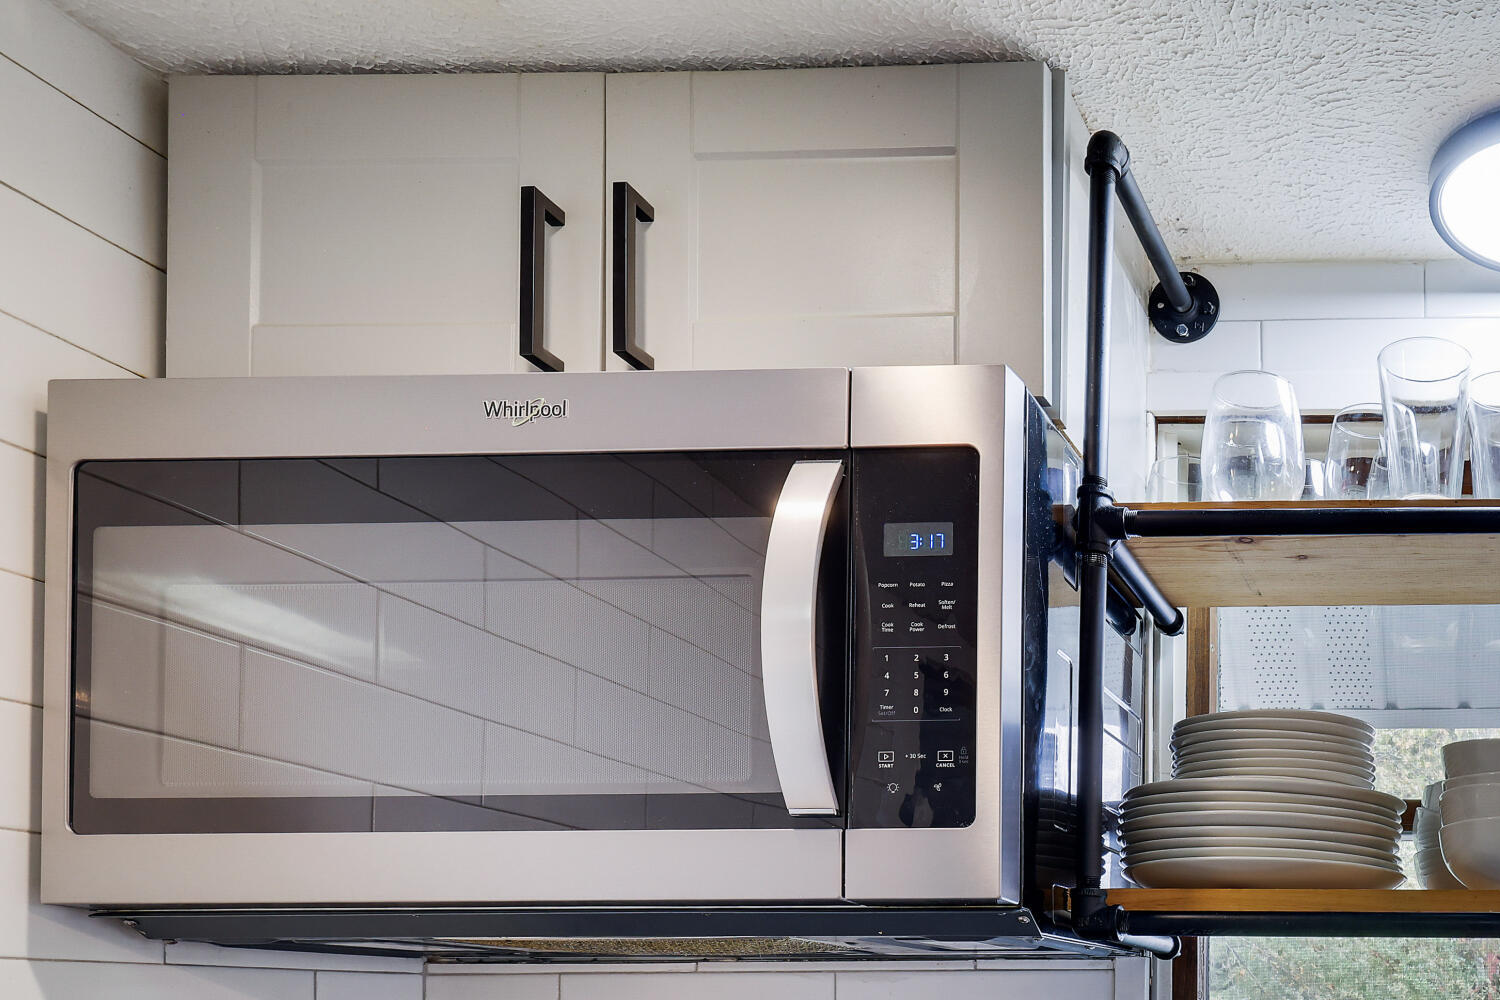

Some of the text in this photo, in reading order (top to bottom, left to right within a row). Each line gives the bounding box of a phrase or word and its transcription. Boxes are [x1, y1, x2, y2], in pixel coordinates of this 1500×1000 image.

[483, 400, 567, 422] Whirlpool
[910, 533, 945, 550] 3:17
[884, 654, 889, 662] 1
[913, 654, 919, 662] 2
[943, 653, 949, 661] 3
[913, 671, 919, 679] 5
[943, 671, 949, 679] 6
[913, 688, 919, 696] 8
[943, 688, 949, 696] 9
[913, 706, 919, 714] 0
